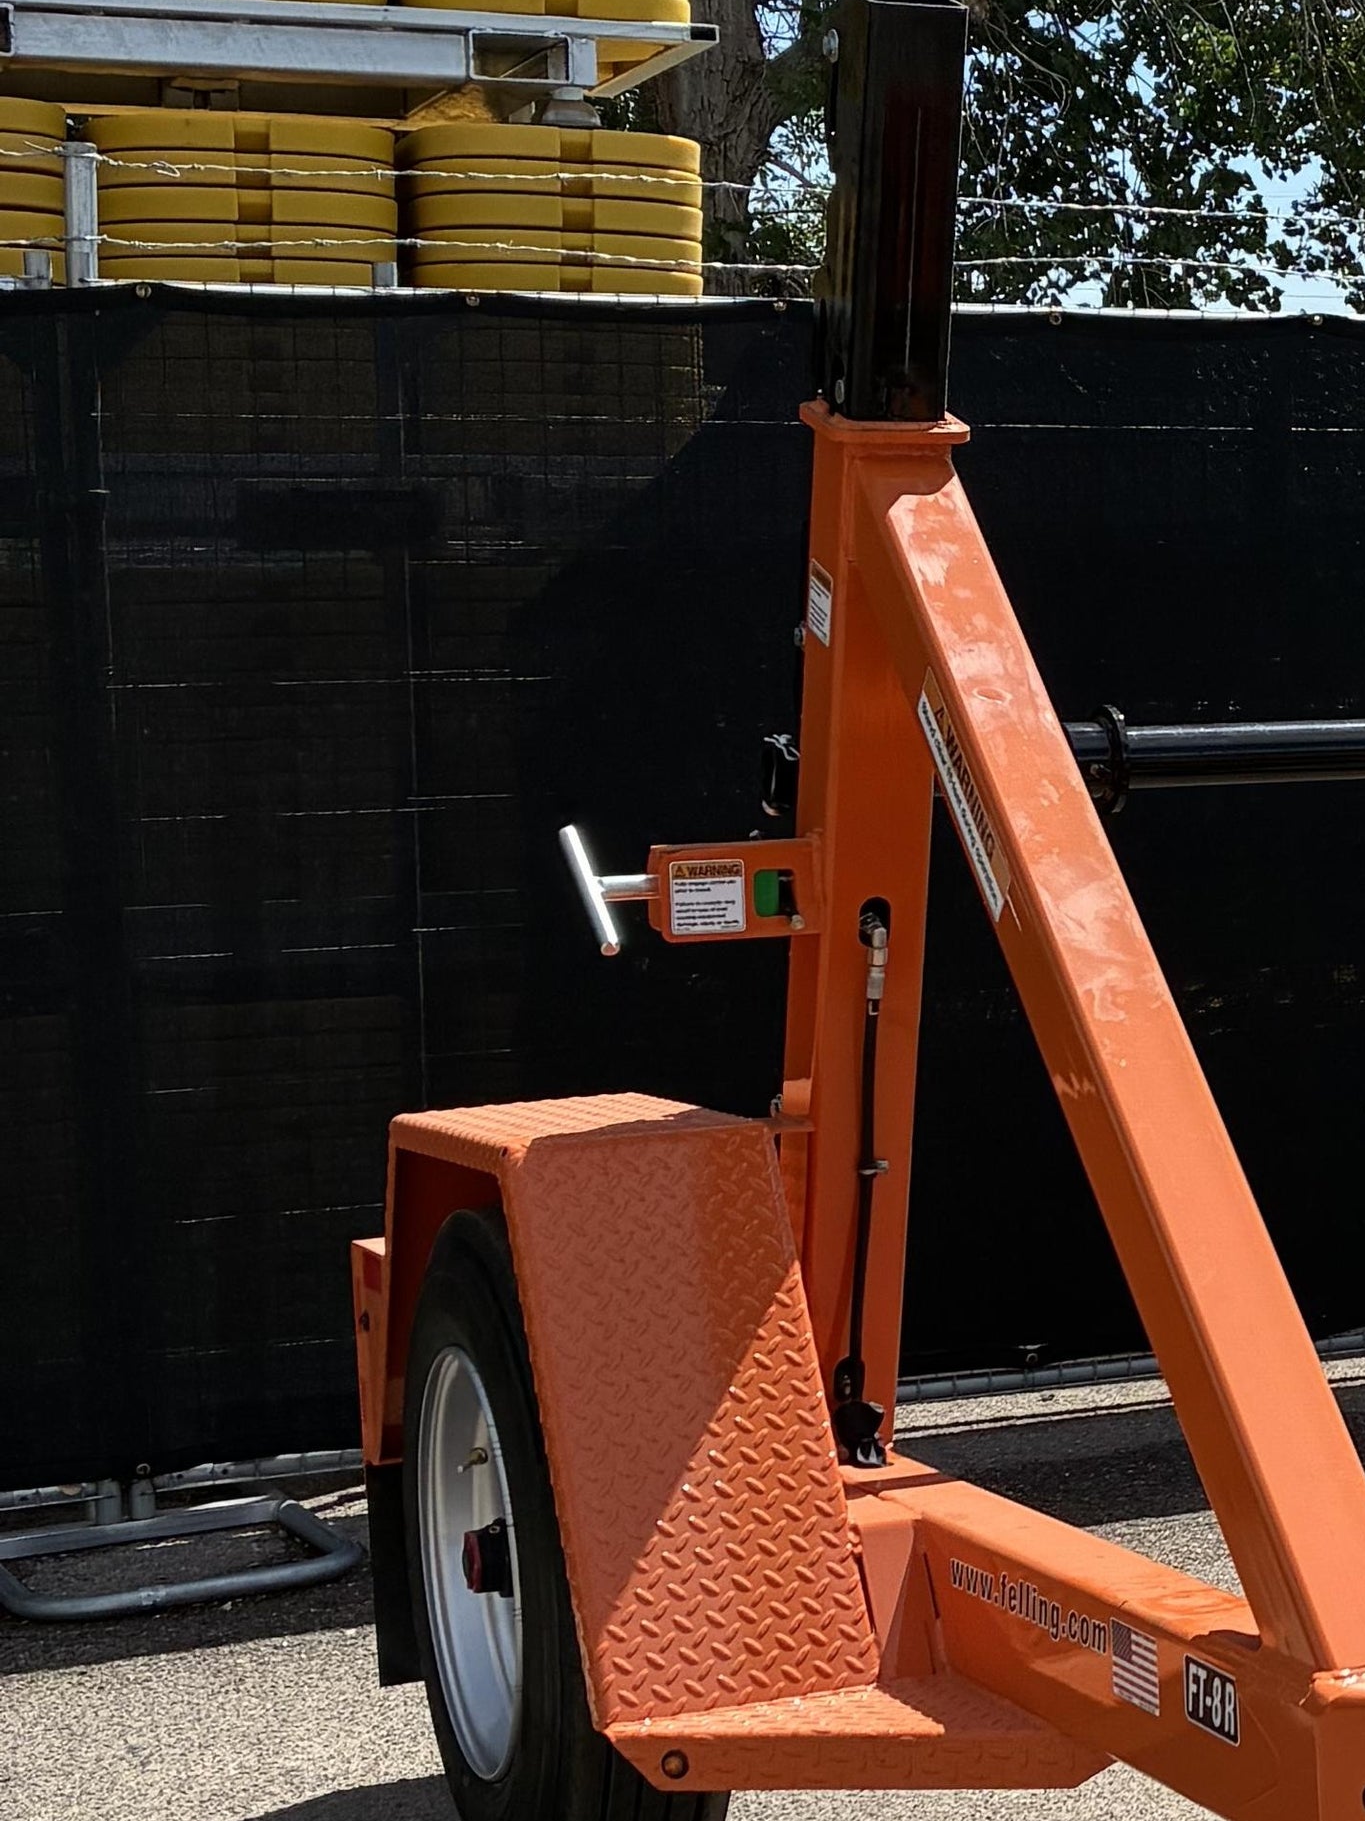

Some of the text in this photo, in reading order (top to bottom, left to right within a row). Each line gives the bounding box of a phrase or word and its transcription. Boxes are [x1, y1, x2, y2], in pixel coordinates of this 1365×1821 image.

[945, 724, 994, 859] WARNING
[687, 864, 740, 877] WARNING
[950, 1558, 1108, 1654] www.felling.com
